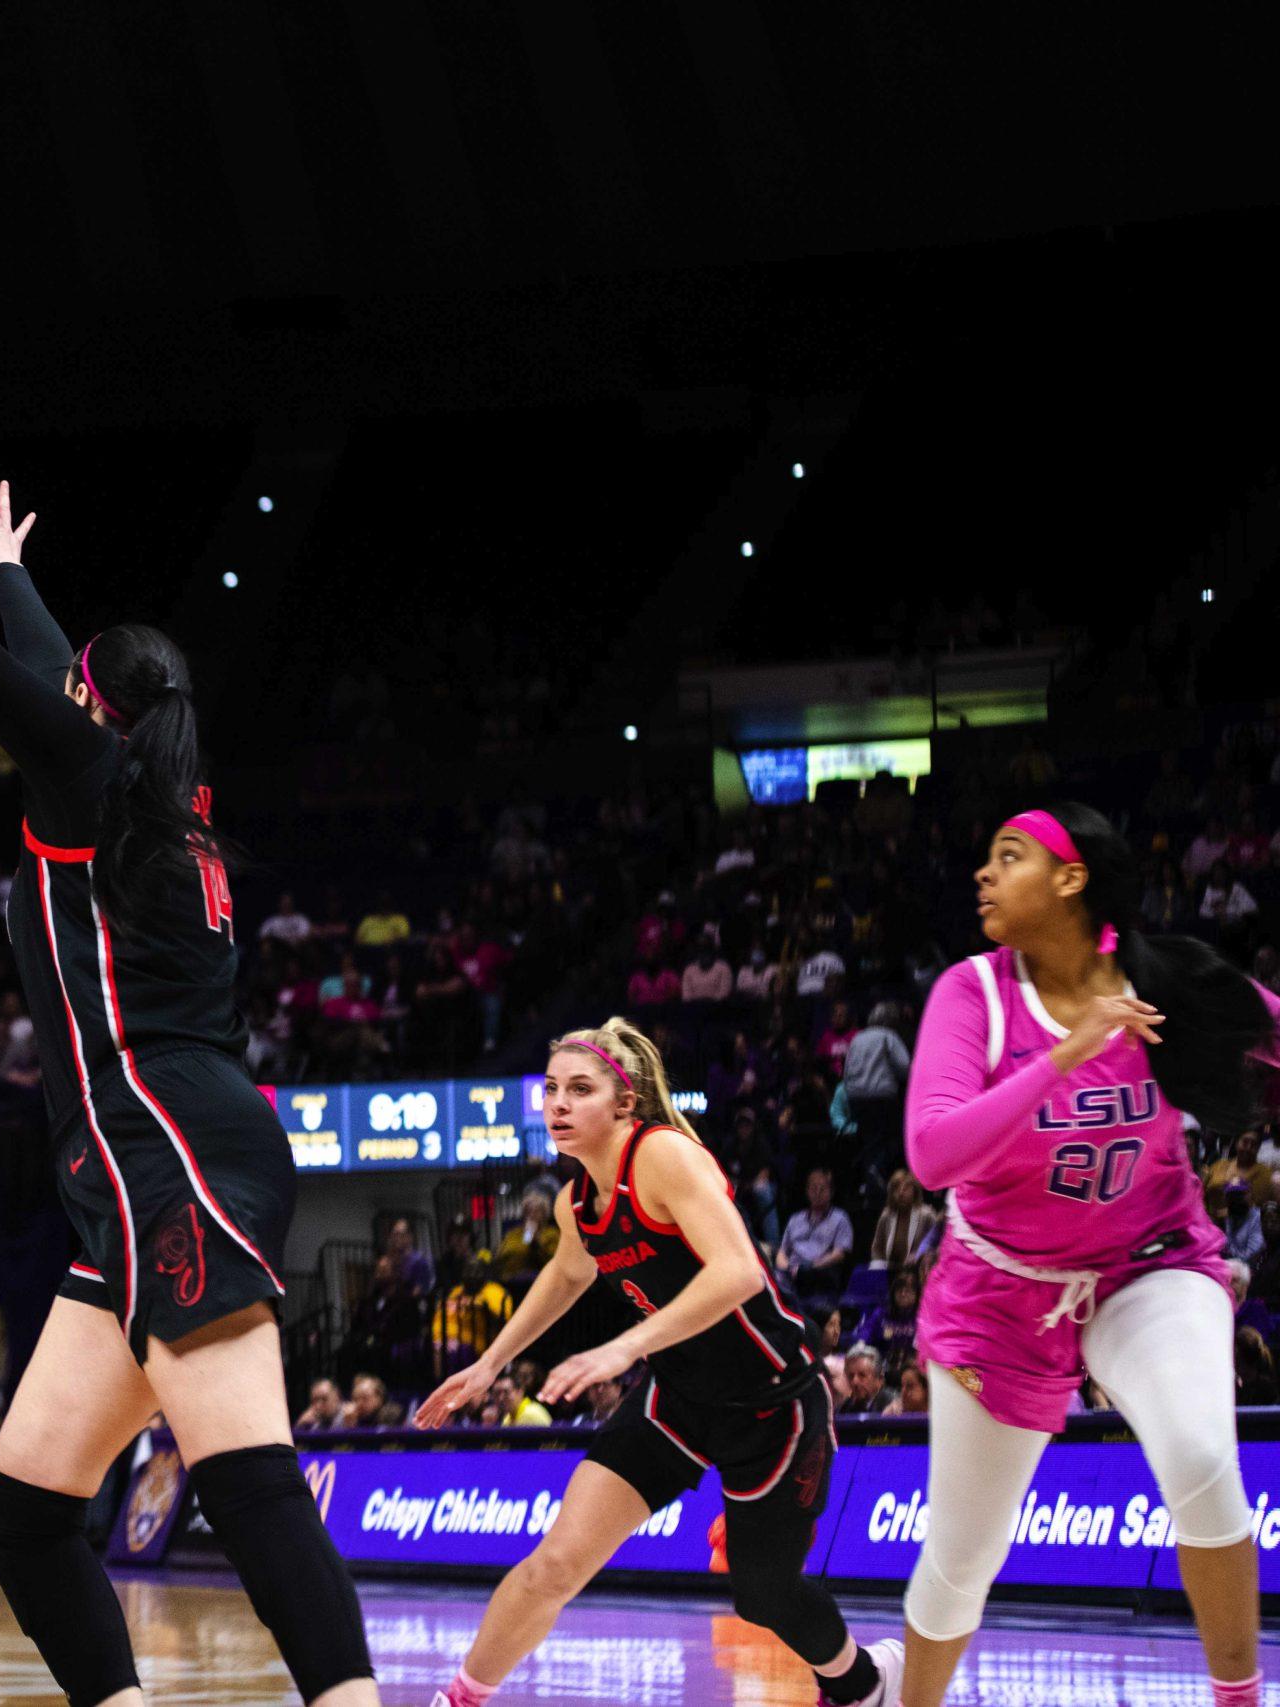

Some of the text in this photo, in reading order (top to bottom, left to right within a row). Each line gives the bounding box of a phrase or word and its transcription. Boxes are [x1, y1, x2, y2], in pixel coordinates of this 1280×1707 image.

[1033, 1079, 1160, 1131] LSU
[423, 1131, 441, 1160] 3
[1043, 1137, 1146, 1205] 20
[596, 1241, 657, 1275] EORGIA
[361, 1486, 435, 1541] Crispy
[431, 1486, 528, 1535] Chicken
[868, 1488, 930, 1542] Cris
[1008, 1490, 1114, 1546] icken
